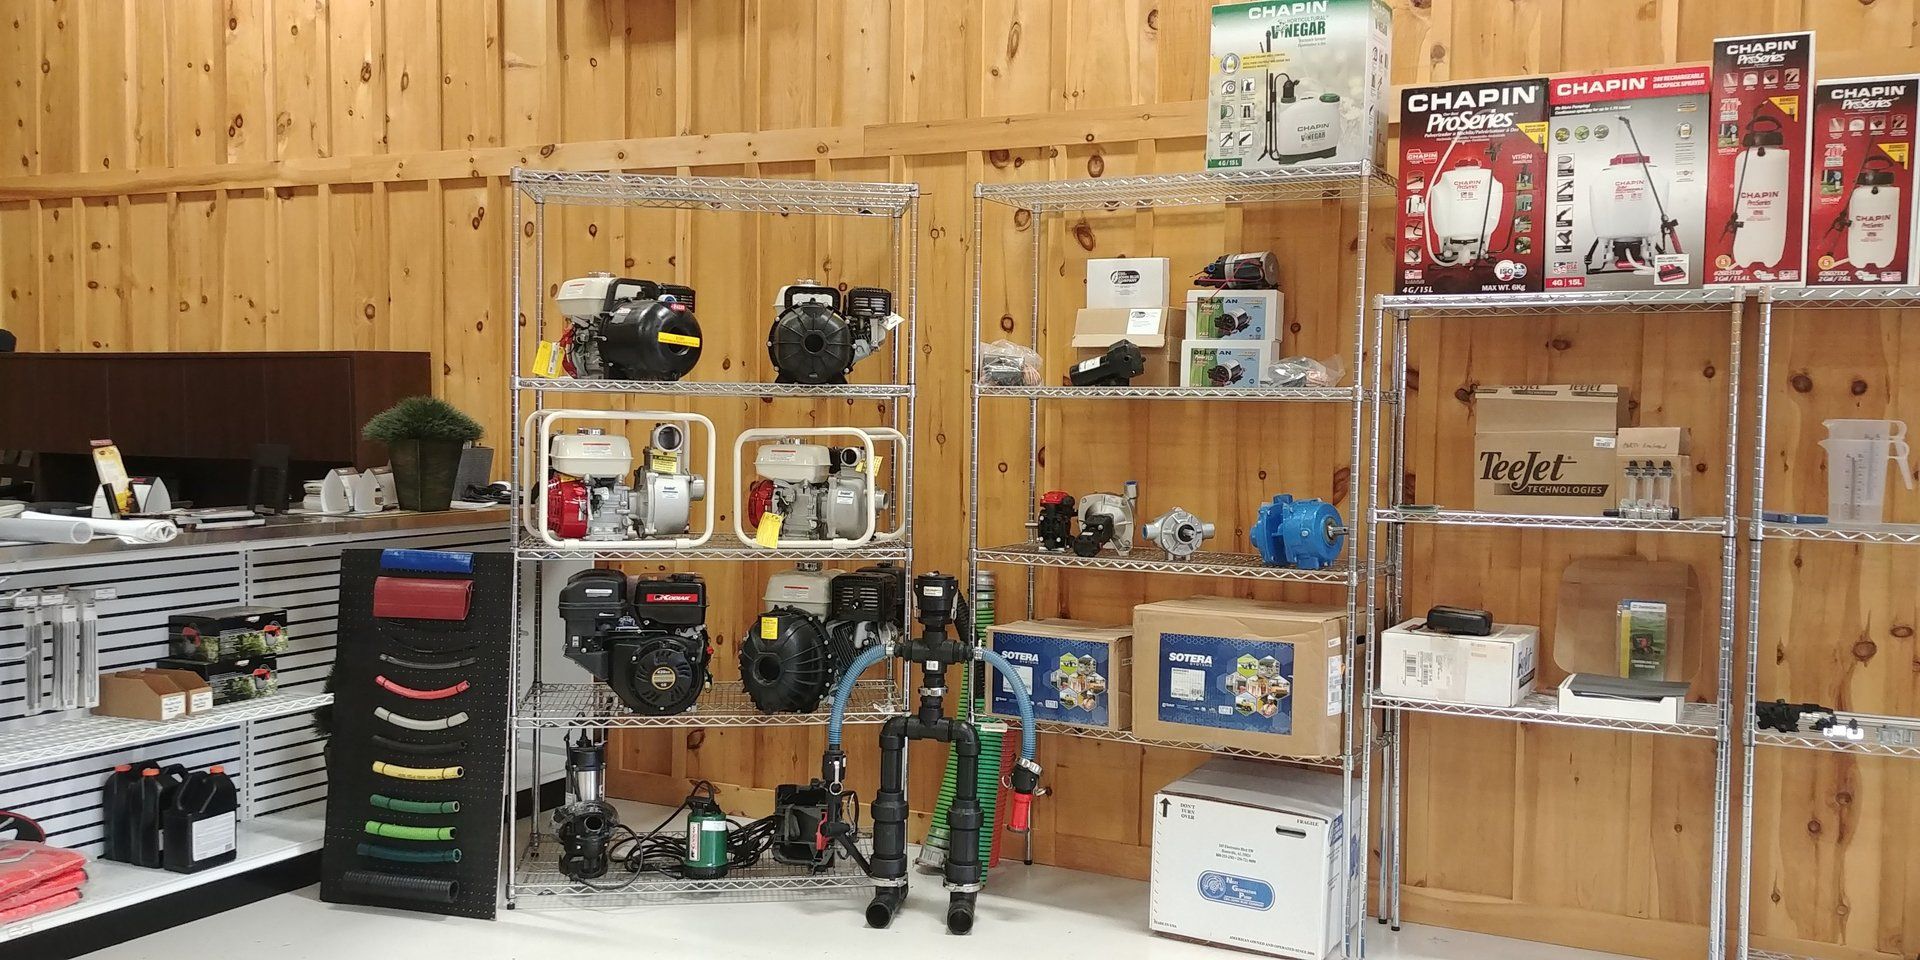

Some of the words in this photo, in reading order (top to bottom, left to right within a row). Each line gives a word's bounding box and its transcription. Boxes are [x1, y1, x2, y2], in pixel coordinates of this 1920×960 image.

[1248, 1, 1328, 20] CHAPIN
[1727, 41, 1798, 55] CHAPIN
[1737, 52, 1786, 65] ProSeries
[1557, 77, 1647, 97] CHAPIN
[1831, 86, 1905, 99] CHAPIN
[1408, 85, 1536, 113] CHAPIN
[1297, 123, 1330, 132] CHAPIN
[1426, 109, 1514, 133] ProSeries
[1741, 191, 1779, 199] CHAPIN
[1480, 451, 1577, 492] TeeJet
[1527, 485, 1602, 494] TECHNOLOGIES
[1001, 650, 1039, 662] SOTERA
[1168, 652, 1213, 664] SOTERA
[1297, 819, 1319, 827] FRAGILE
